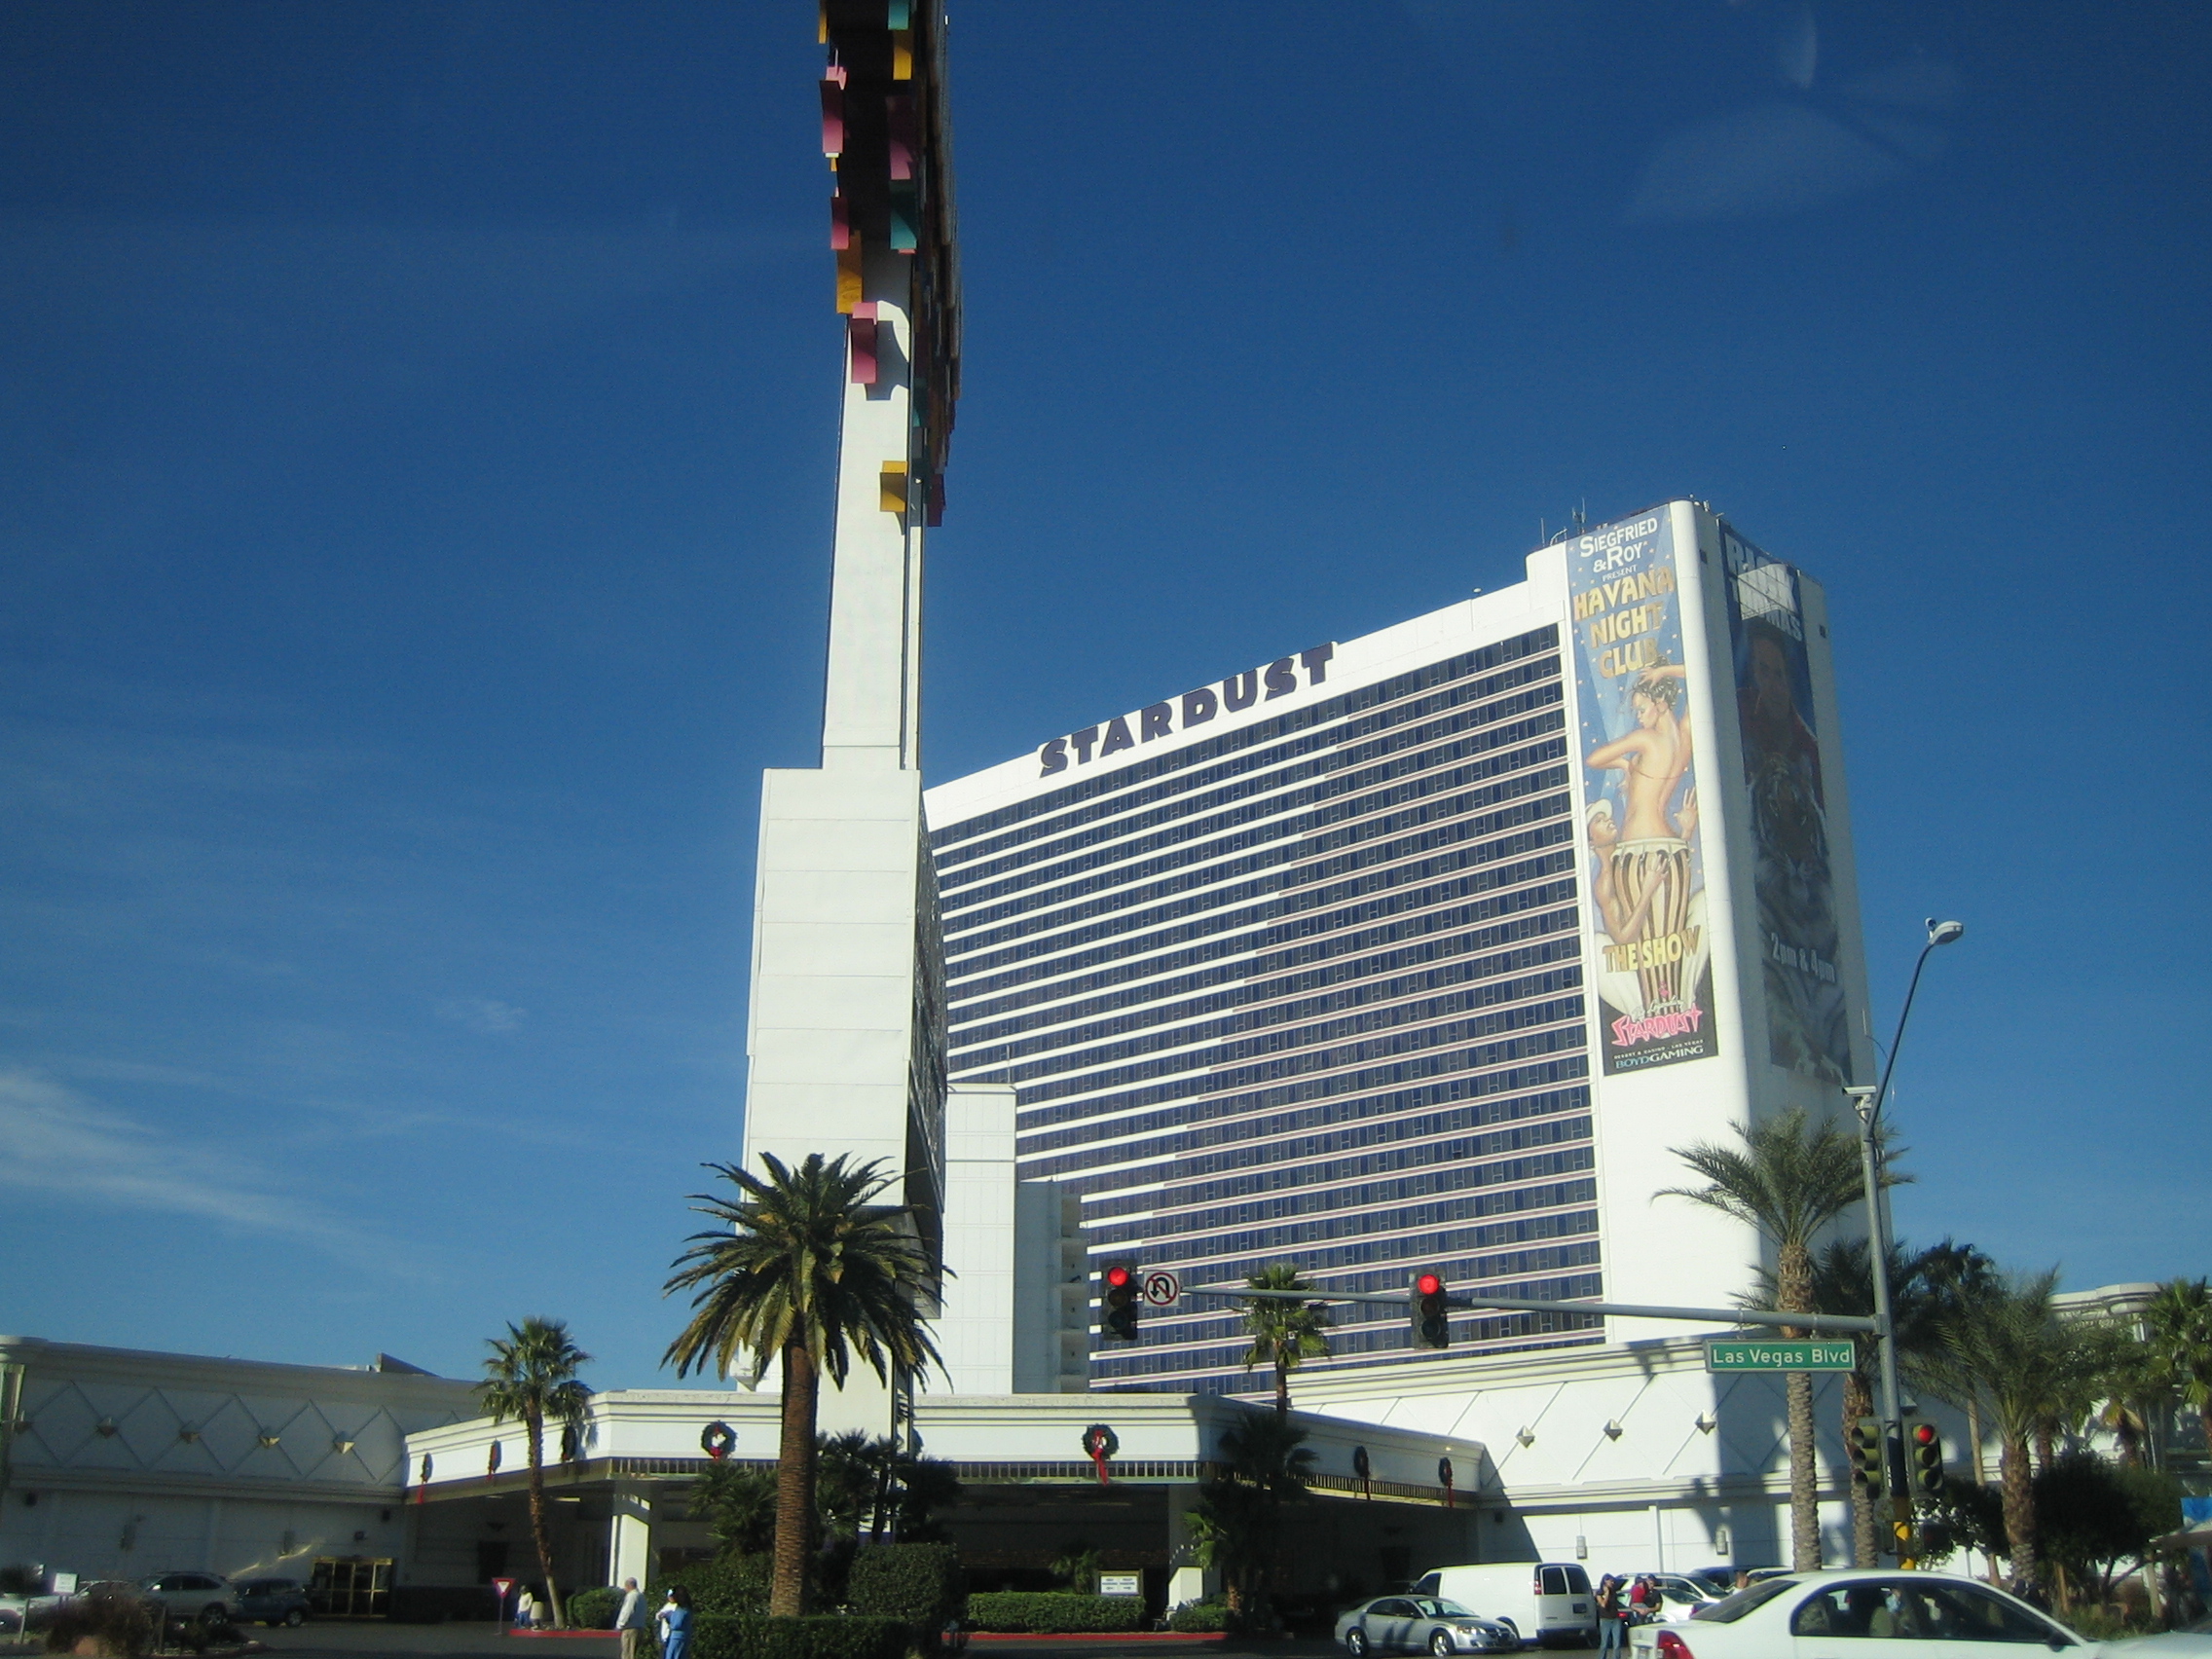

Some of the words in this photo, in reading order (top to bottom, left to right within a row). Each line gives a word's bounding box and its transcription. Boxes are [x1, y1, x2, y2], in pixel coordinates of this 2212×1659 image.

[1579, 517, 1658, 558] SIEGFRIED
[1572, 566, 1676, 622] HAVANA
[1602, 565, 1638, 582] PRESENT
[1590, 601, 1664, 649] NIGHT
[1600, 638, 1659, 680] CLUB
[1039, 642, 1334, 778] STARDUST
[1603, 942, 1639, 973] THE
[1641, 925, 1701, 969] SHOW
[1771, 932, 1797, 968] 2pm
[1611, 1002, 1704, 1047] STARDUST
[1713, 1348, 1745, 1364] Las
[1750, 1348, 1804, 1368] Vegas
[1811, 1348, 1851, 1363] Blvd
